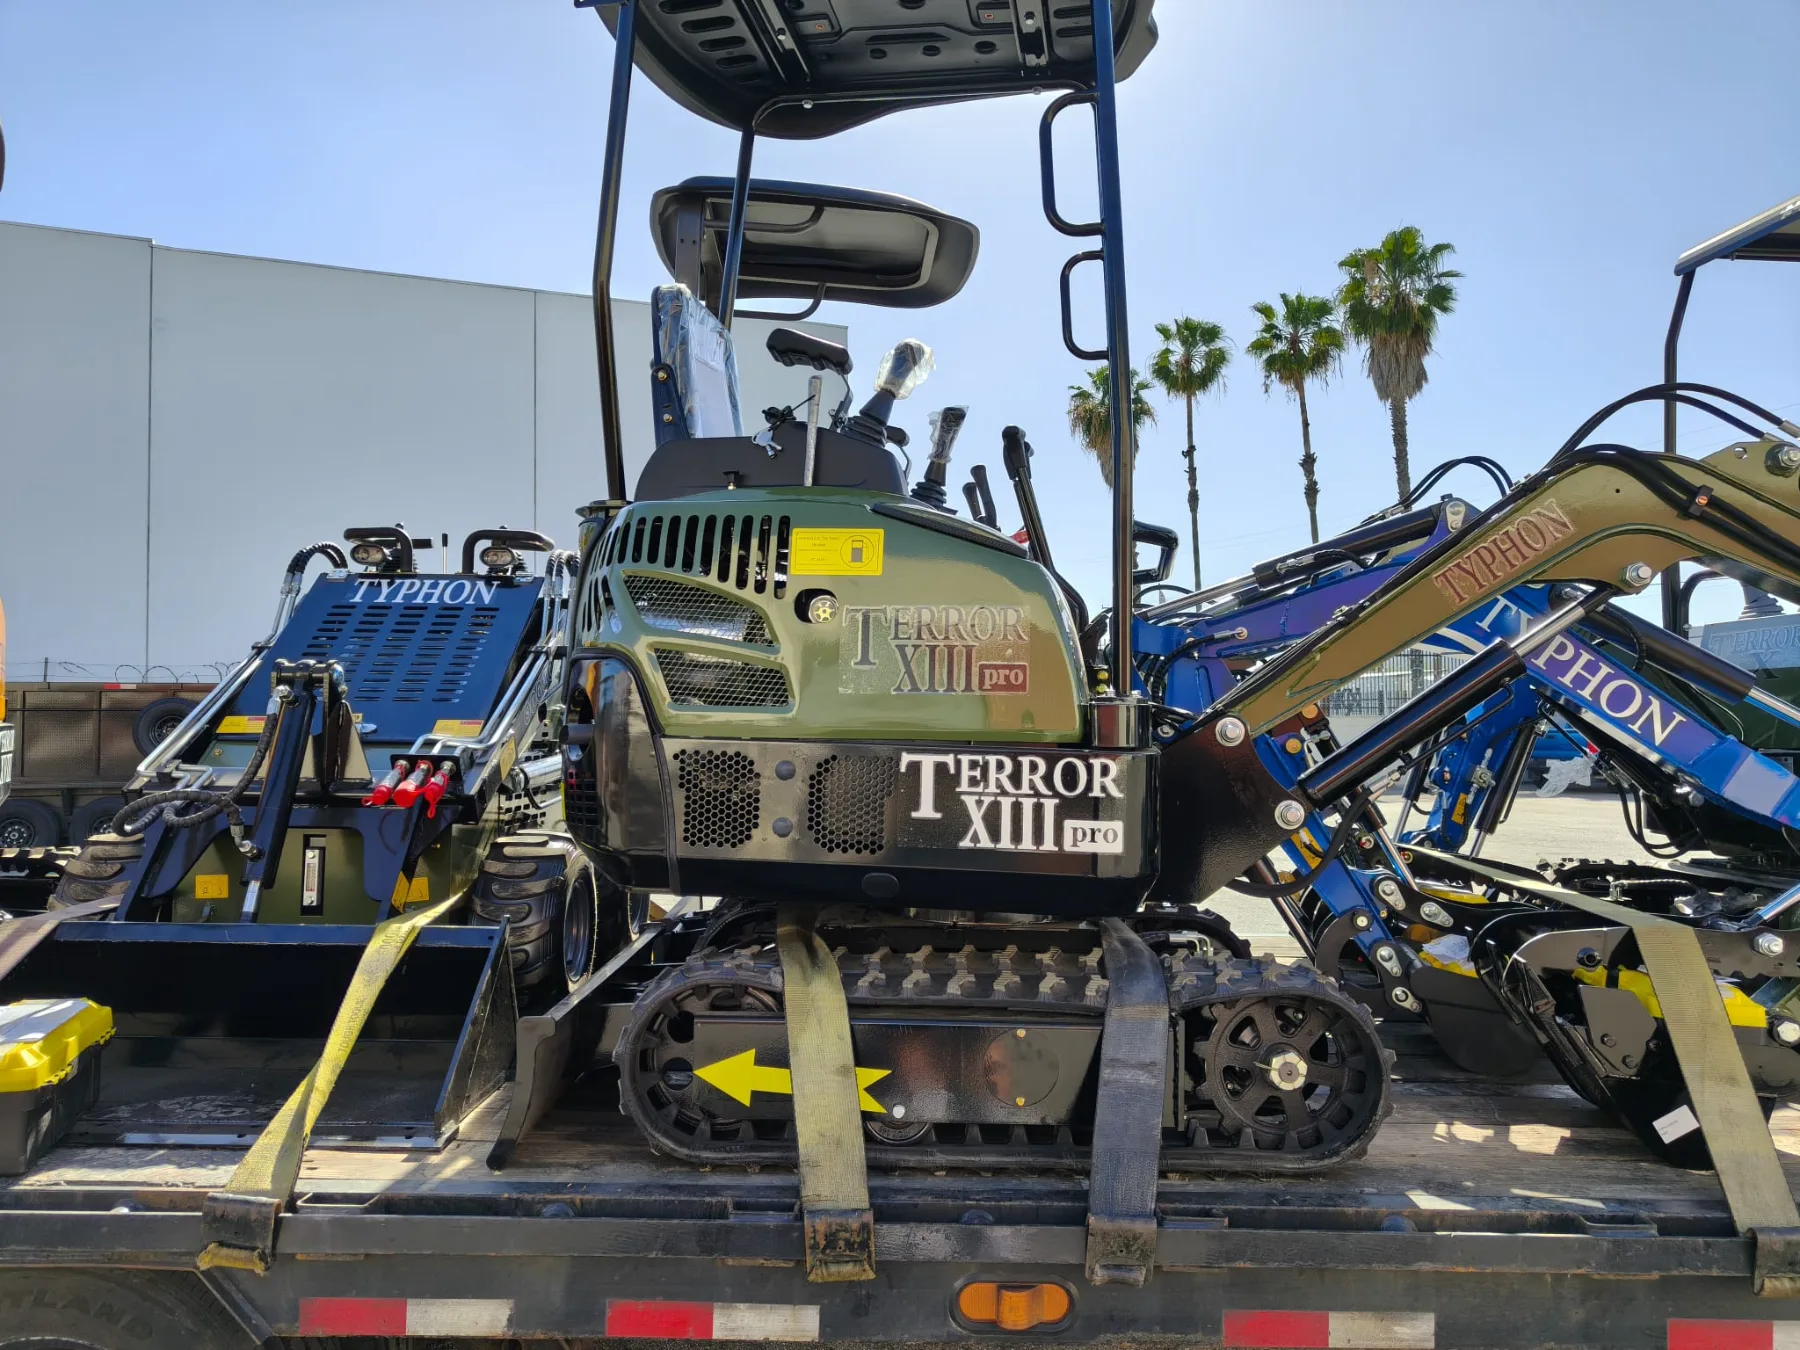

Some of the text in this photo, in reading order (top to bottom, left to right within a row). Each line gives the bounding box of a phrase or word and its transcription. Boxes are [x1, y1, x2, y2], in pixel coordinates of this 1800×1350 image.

[1433, 499, 1575, 605] TYPHON
[350, 578, 500, 605] TYPHON
[843, 605, 1029, 669] TERROR
[892, 643, 1024, 694] XIII pro
[901, 752, 1124, 820] TERROR
[959, 795, 1119, 852] XIII pro
